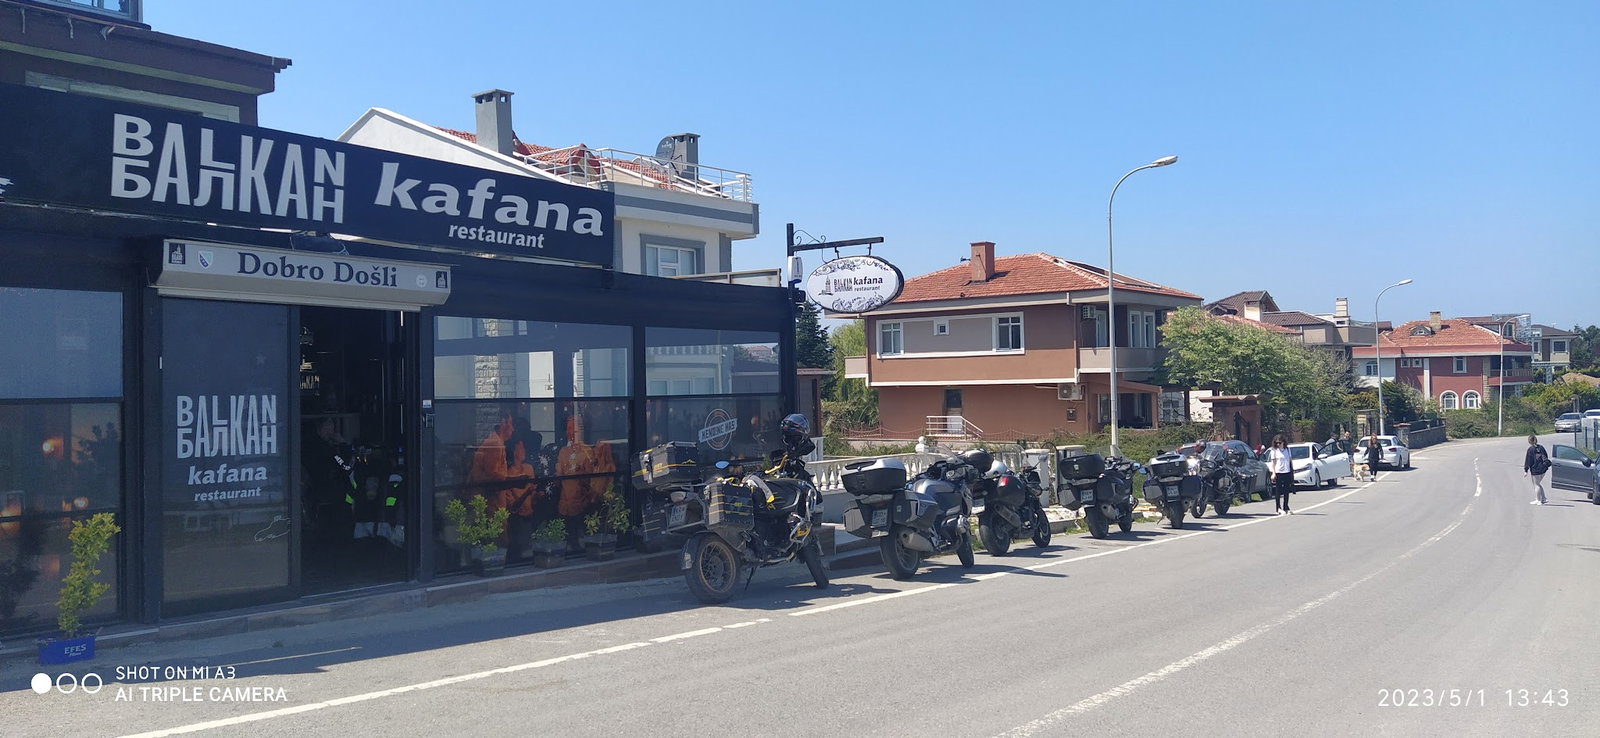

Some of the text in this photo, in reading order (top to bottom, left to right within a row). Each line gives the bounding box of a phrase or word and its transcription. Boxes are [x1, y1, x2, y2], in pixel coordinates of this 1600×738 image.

[111, 113, 604, 236] BALKAN kafana
[448, 224, 545, 248] restaurant
[237, 251, 398, 287] Dobro Došli
[853, 276, 883, 285] kafana
[188, 464, 268, 485] kafana
[194, 487, 261, 501] restaurant
[64, 644, 87, 655] EFES
